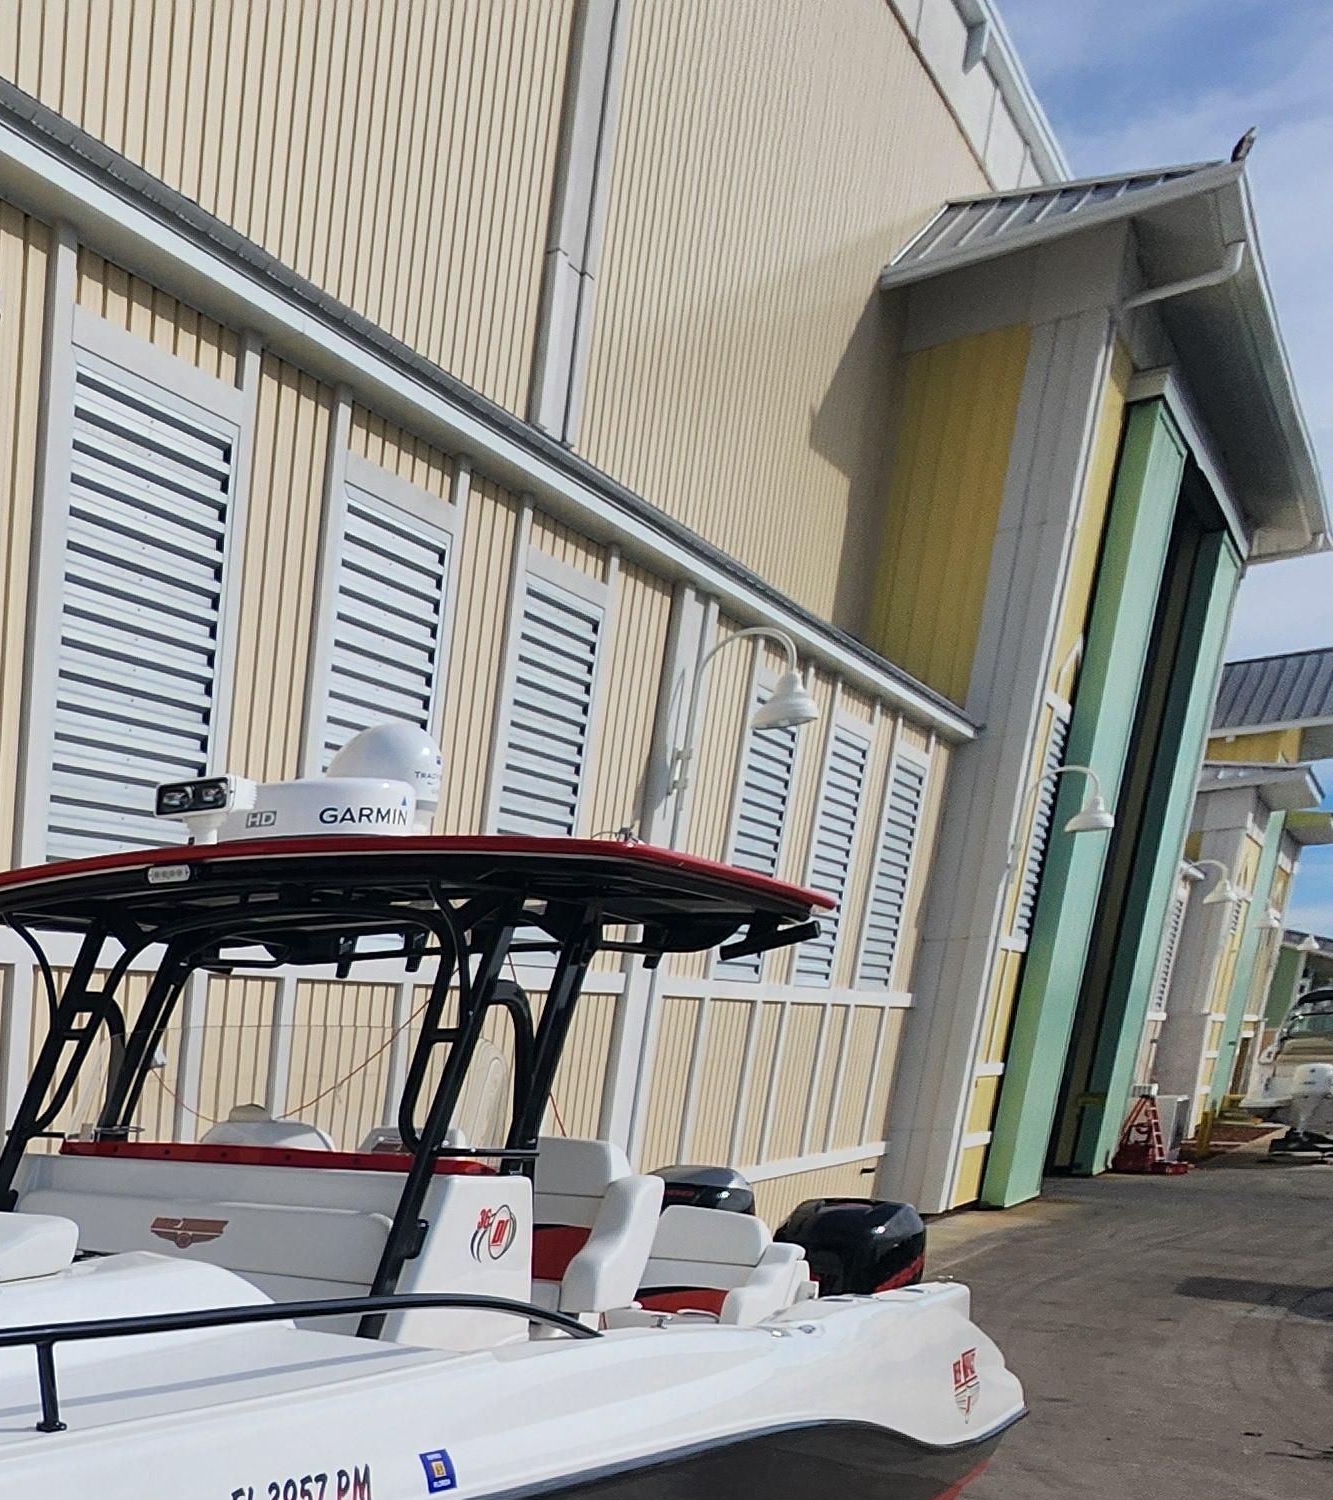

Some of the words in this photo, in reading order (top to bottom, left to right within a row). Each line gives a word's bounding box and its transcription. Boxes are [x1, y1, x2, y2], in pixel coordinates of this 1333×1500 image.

[247, 811, 276, 828] HD
[319, 807, 408, 826] GARMIN
[477, 1208, 492, 1229] 36
